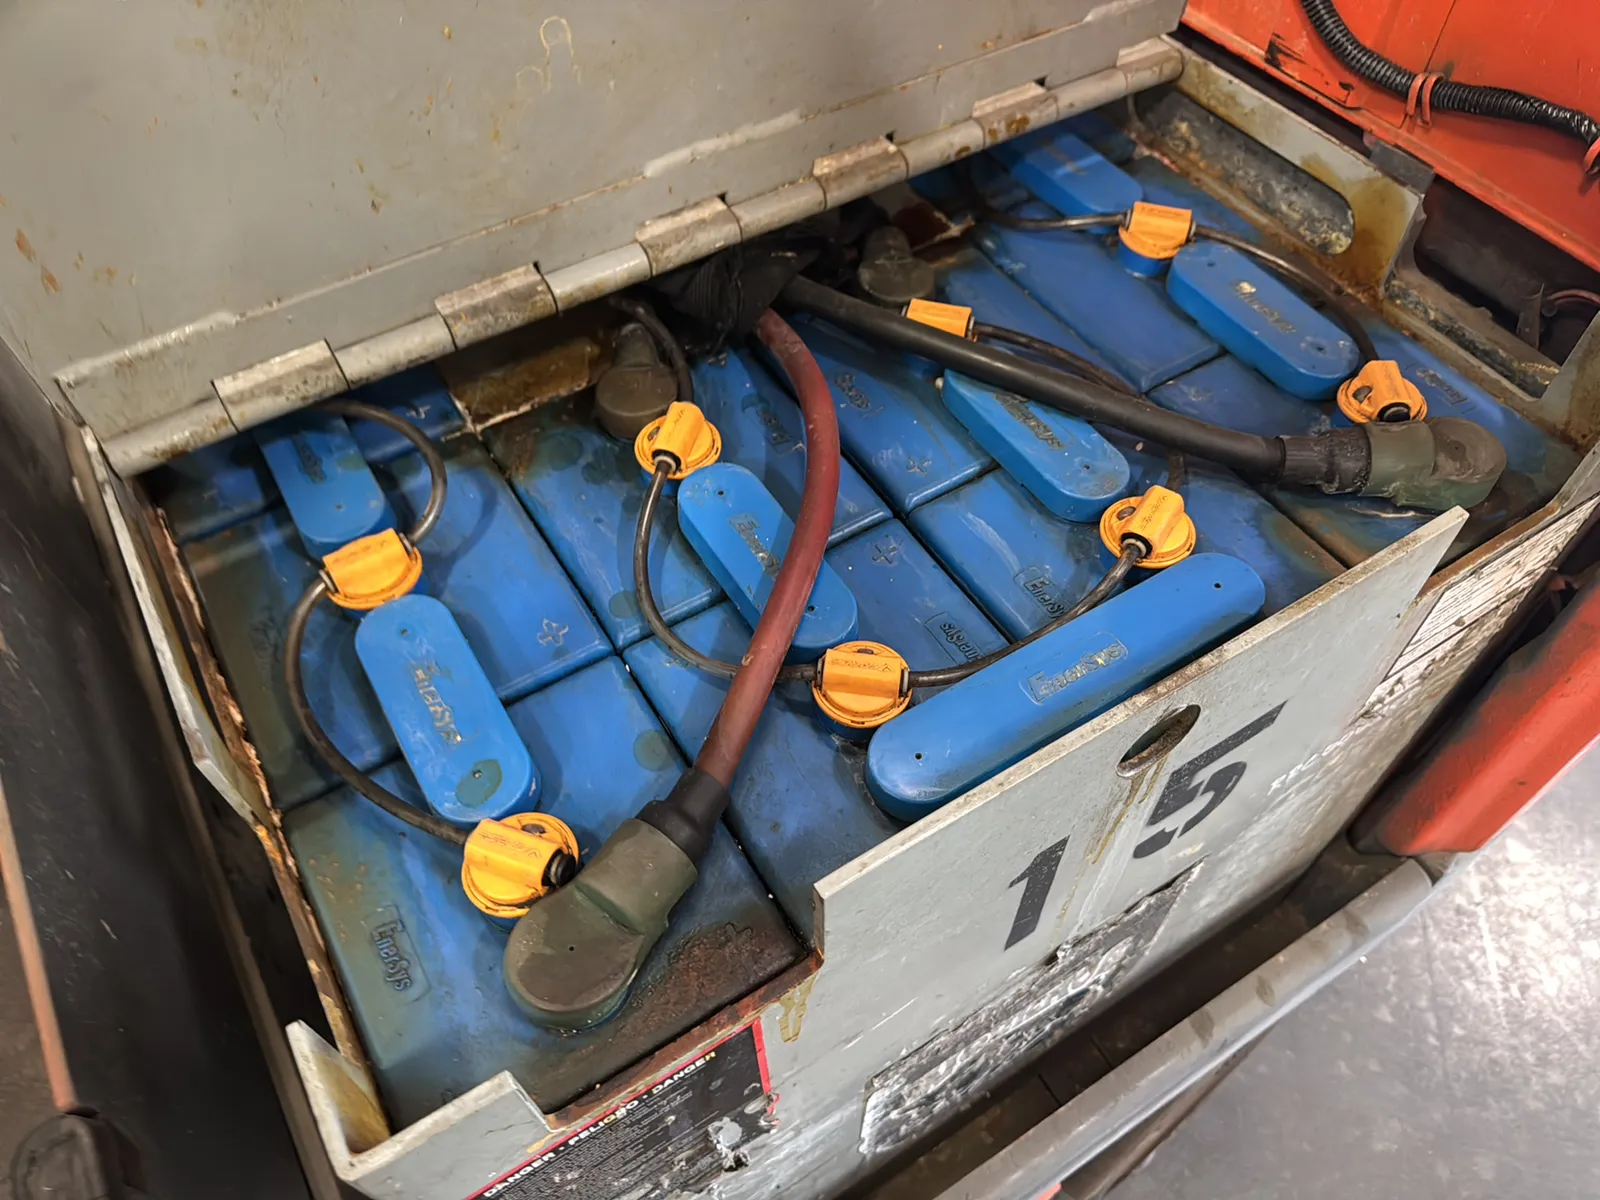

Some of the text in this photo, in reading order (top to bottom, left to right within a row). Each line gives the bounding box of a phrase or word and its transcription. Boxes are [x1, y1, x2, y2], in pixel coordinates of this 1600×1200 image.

[1024, 577, 1070, 620] EnerSy
[940, 621, 984, 662] nerSys
[370, 919, 413, 990] EnerSys
[482, 1152, 556, 1197] DANGER
[651, 1051, 716, 1094] DANGER
